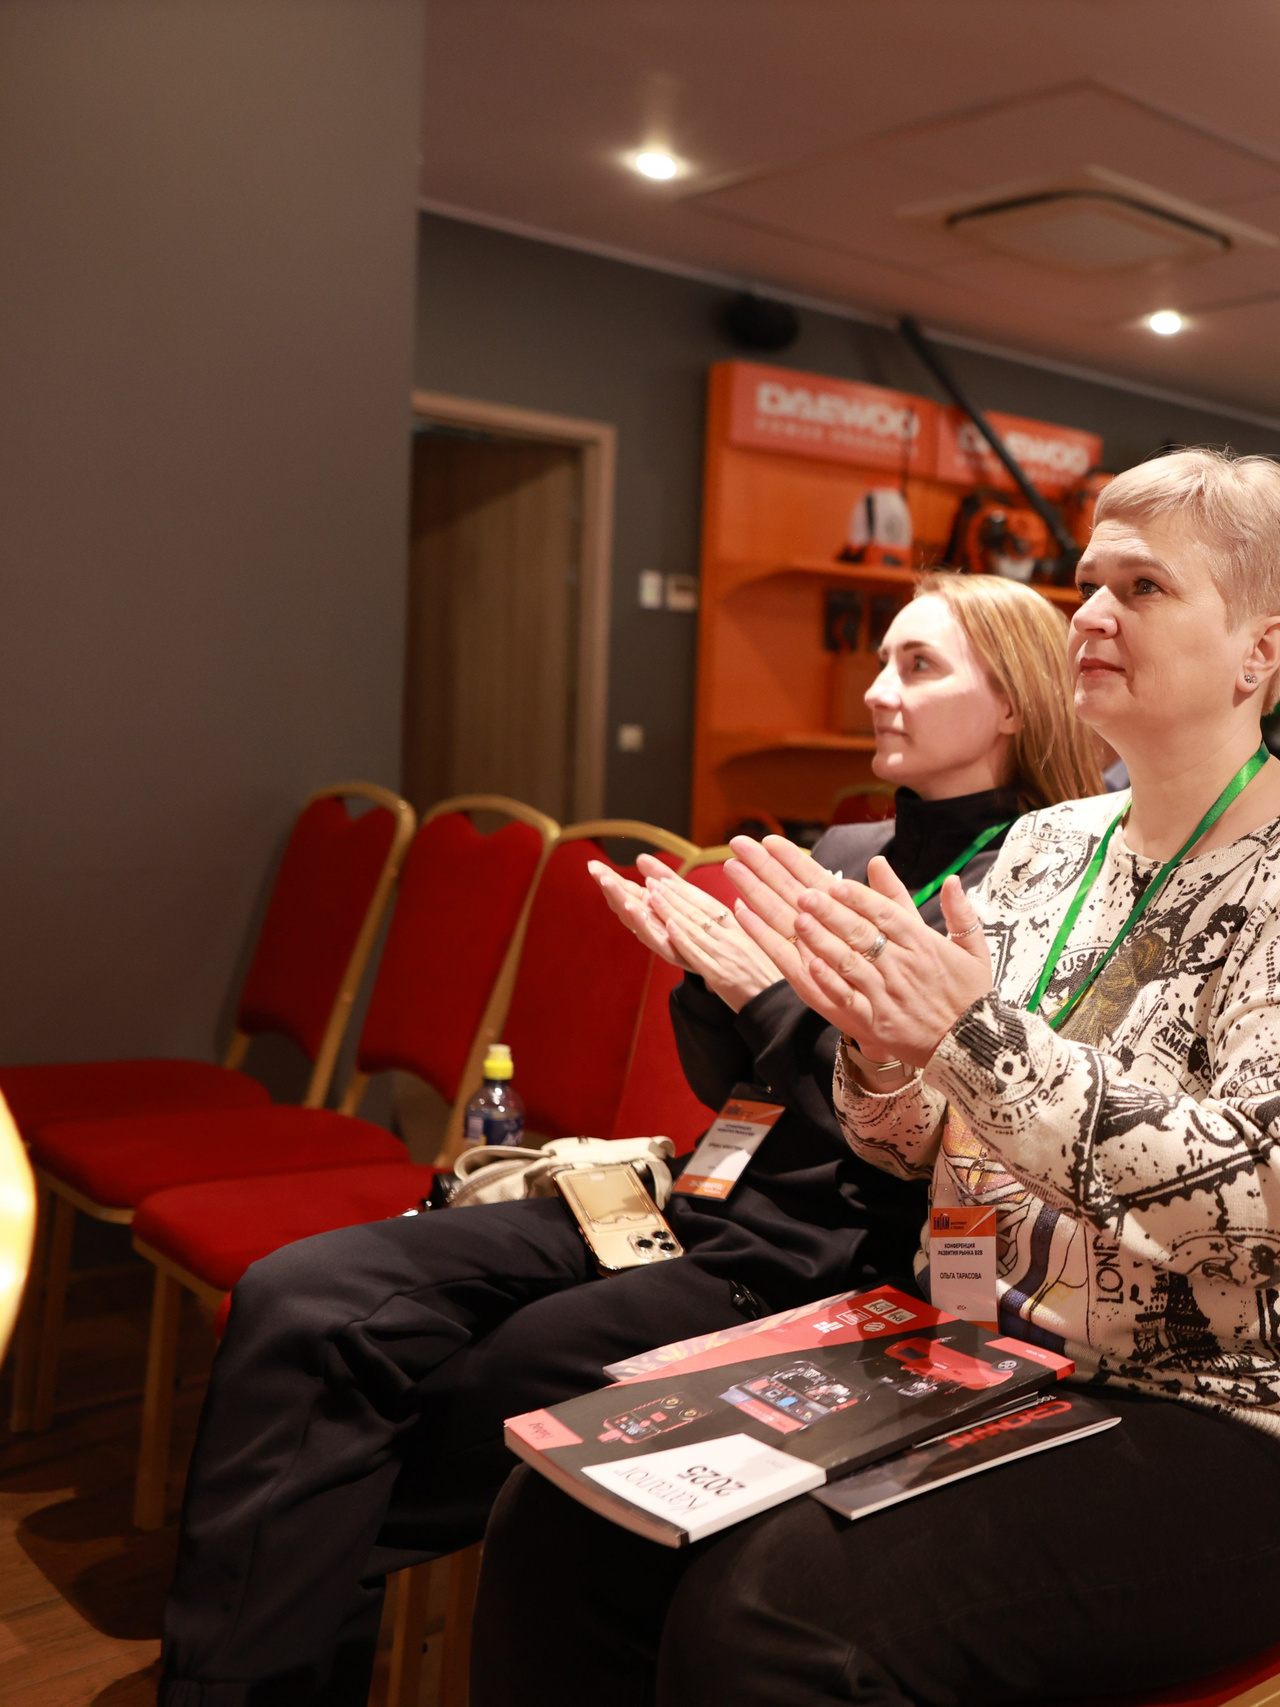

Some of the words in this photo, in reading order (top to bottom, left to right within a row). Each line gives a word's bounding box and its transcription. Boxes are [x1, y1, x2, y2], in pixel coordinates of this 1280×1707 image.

[756, 381, 920, 438] DAEWOO
[989, 1088, 1050, 1123] CHINA
[944, 1242, 976, 1250] КОНФЕРЕНЦИЯ
[940, 1272, 955, 1280] ОЛЬГА
[956, 1272, 982, 1280] ТАРАСОВА
[677, 1465, 747, 1497] 2025
